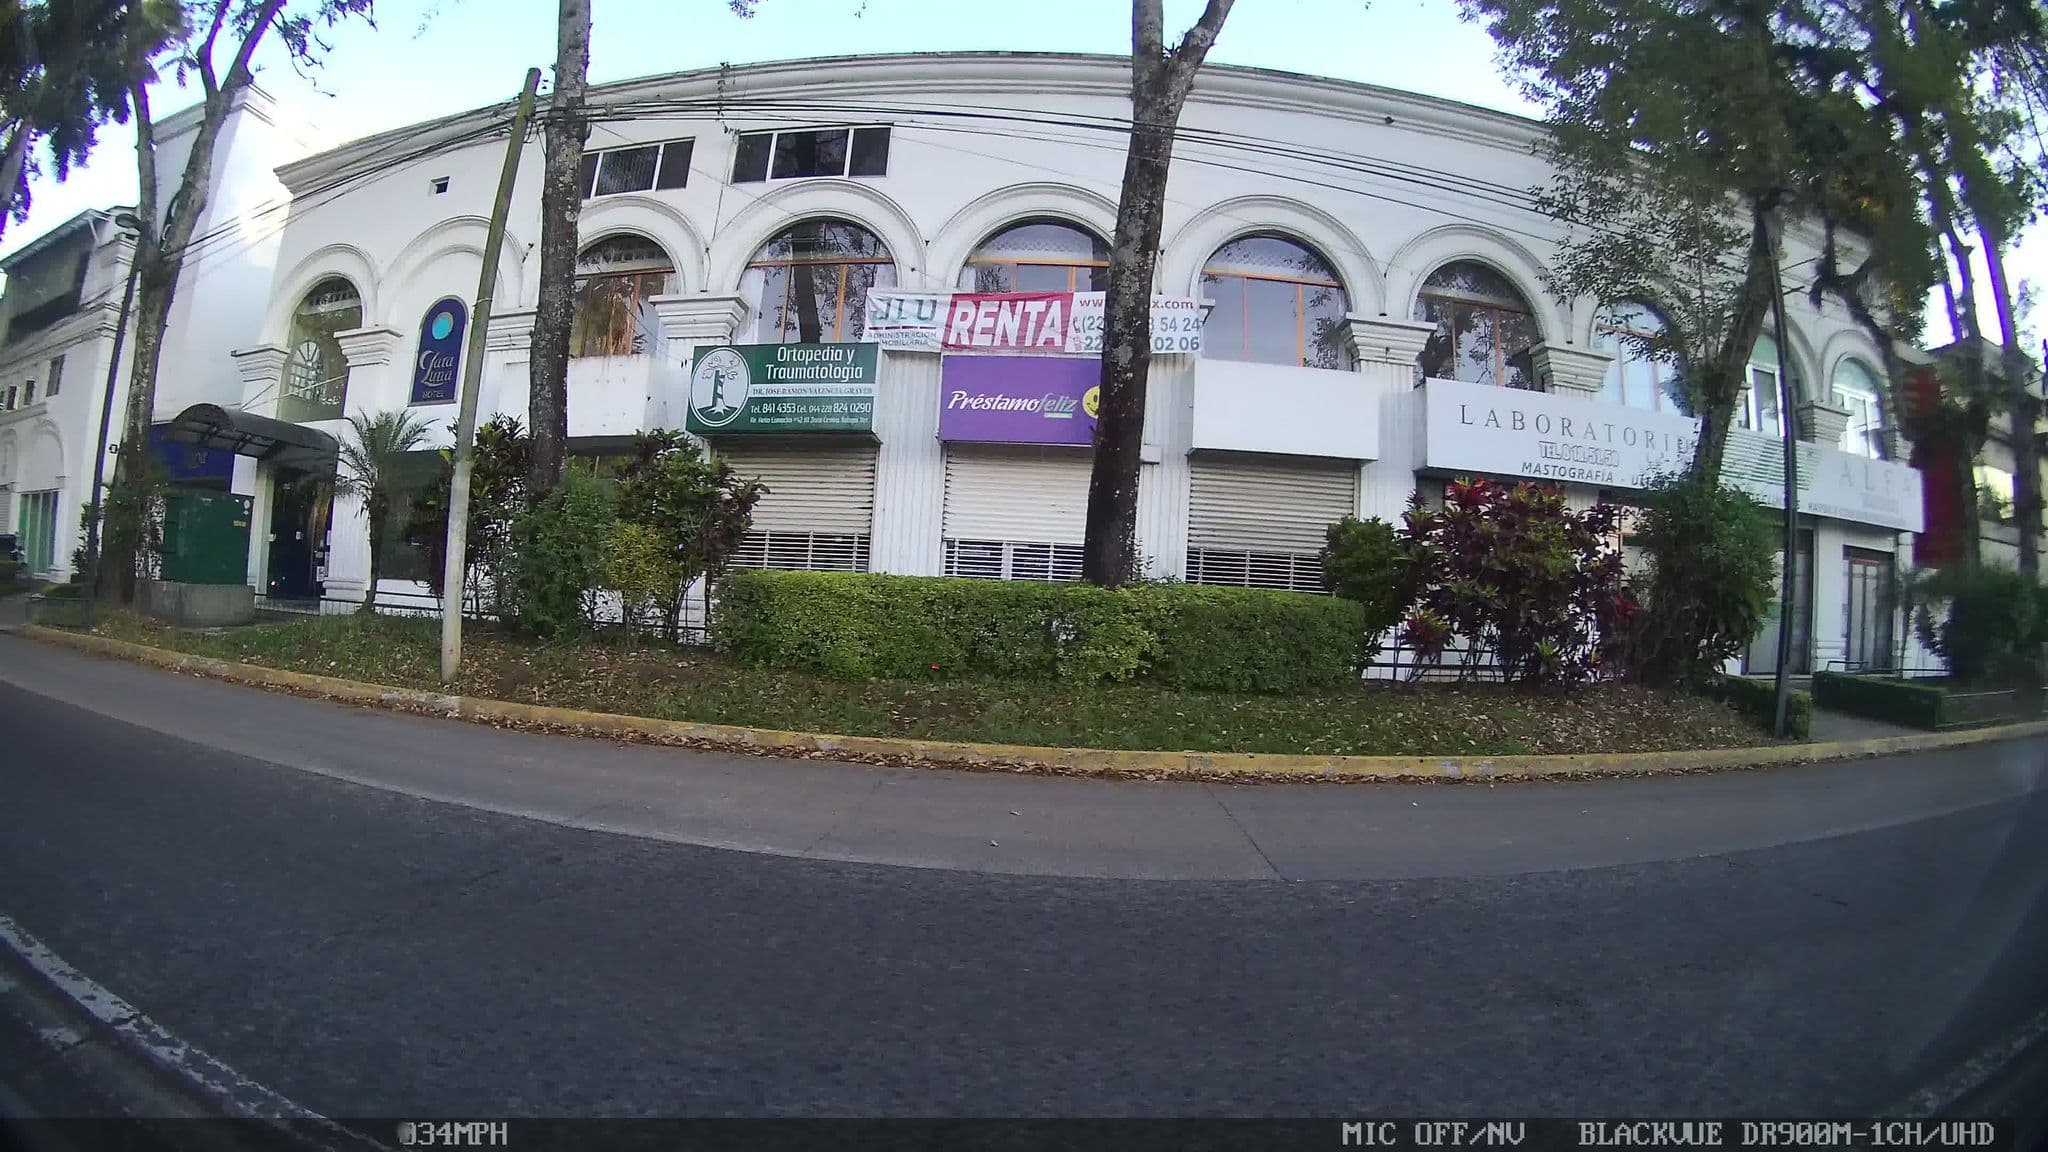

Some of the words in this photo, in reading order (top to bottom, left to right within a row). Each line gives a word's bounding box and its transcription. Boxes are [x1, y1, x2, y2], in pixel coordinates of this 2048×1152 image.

[951, 299, 1064, 346] RENTA
[1160, 317, 1178, 332] 54
[1183, 318, 1200, 332] 24
[1180, 337, 1199, 350] 06
[777, 346, 843, 364] Ortopedia
[846, 347, 855, 362] y
[762, 403, 775, 413] 841
[777, 403, 796, 413] 4353
[833, 403, 848, 413] 824
[850, 403, 871, 413] 0290
